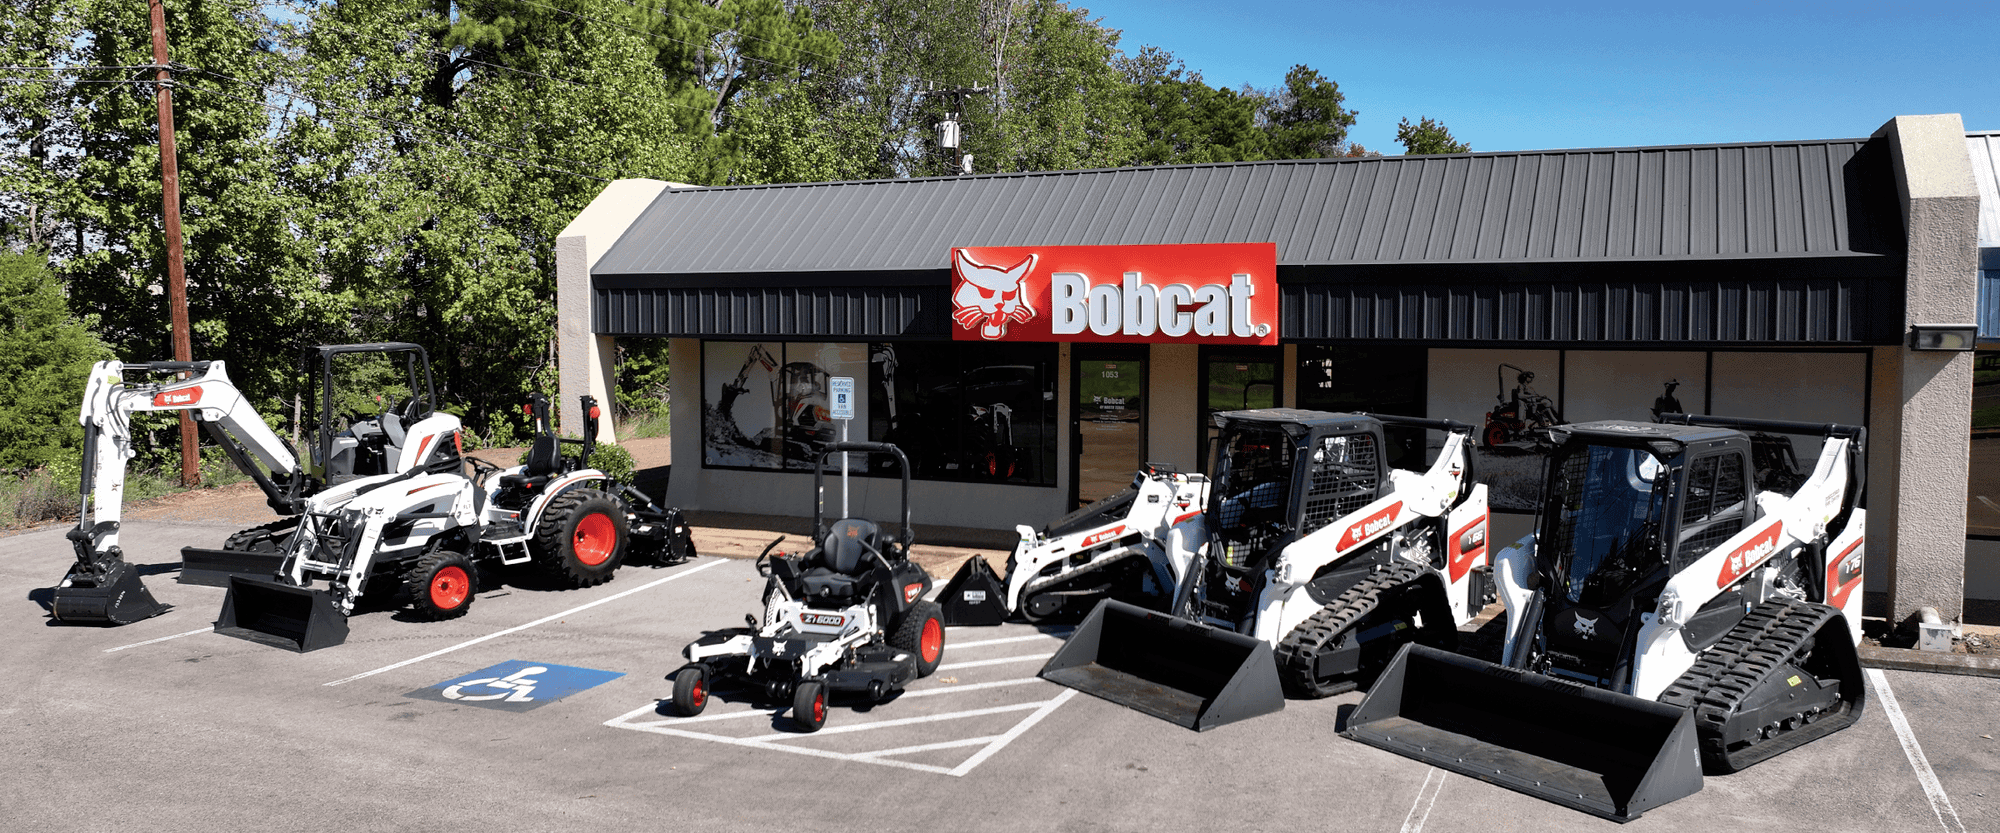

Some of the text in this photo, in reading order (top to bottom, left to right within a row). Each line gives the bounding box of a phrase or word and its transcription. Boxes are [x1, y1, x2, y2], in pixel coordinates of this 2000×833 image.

[1101, 370, 1119, 378] 1053
[172, 393, 191, 403] Bobcat
[1103, 396, 1125, 405] Bobcat
[1364, 513, 1392, 537] Bobcat
[1744, 536, 1774, 568] Bobcat
